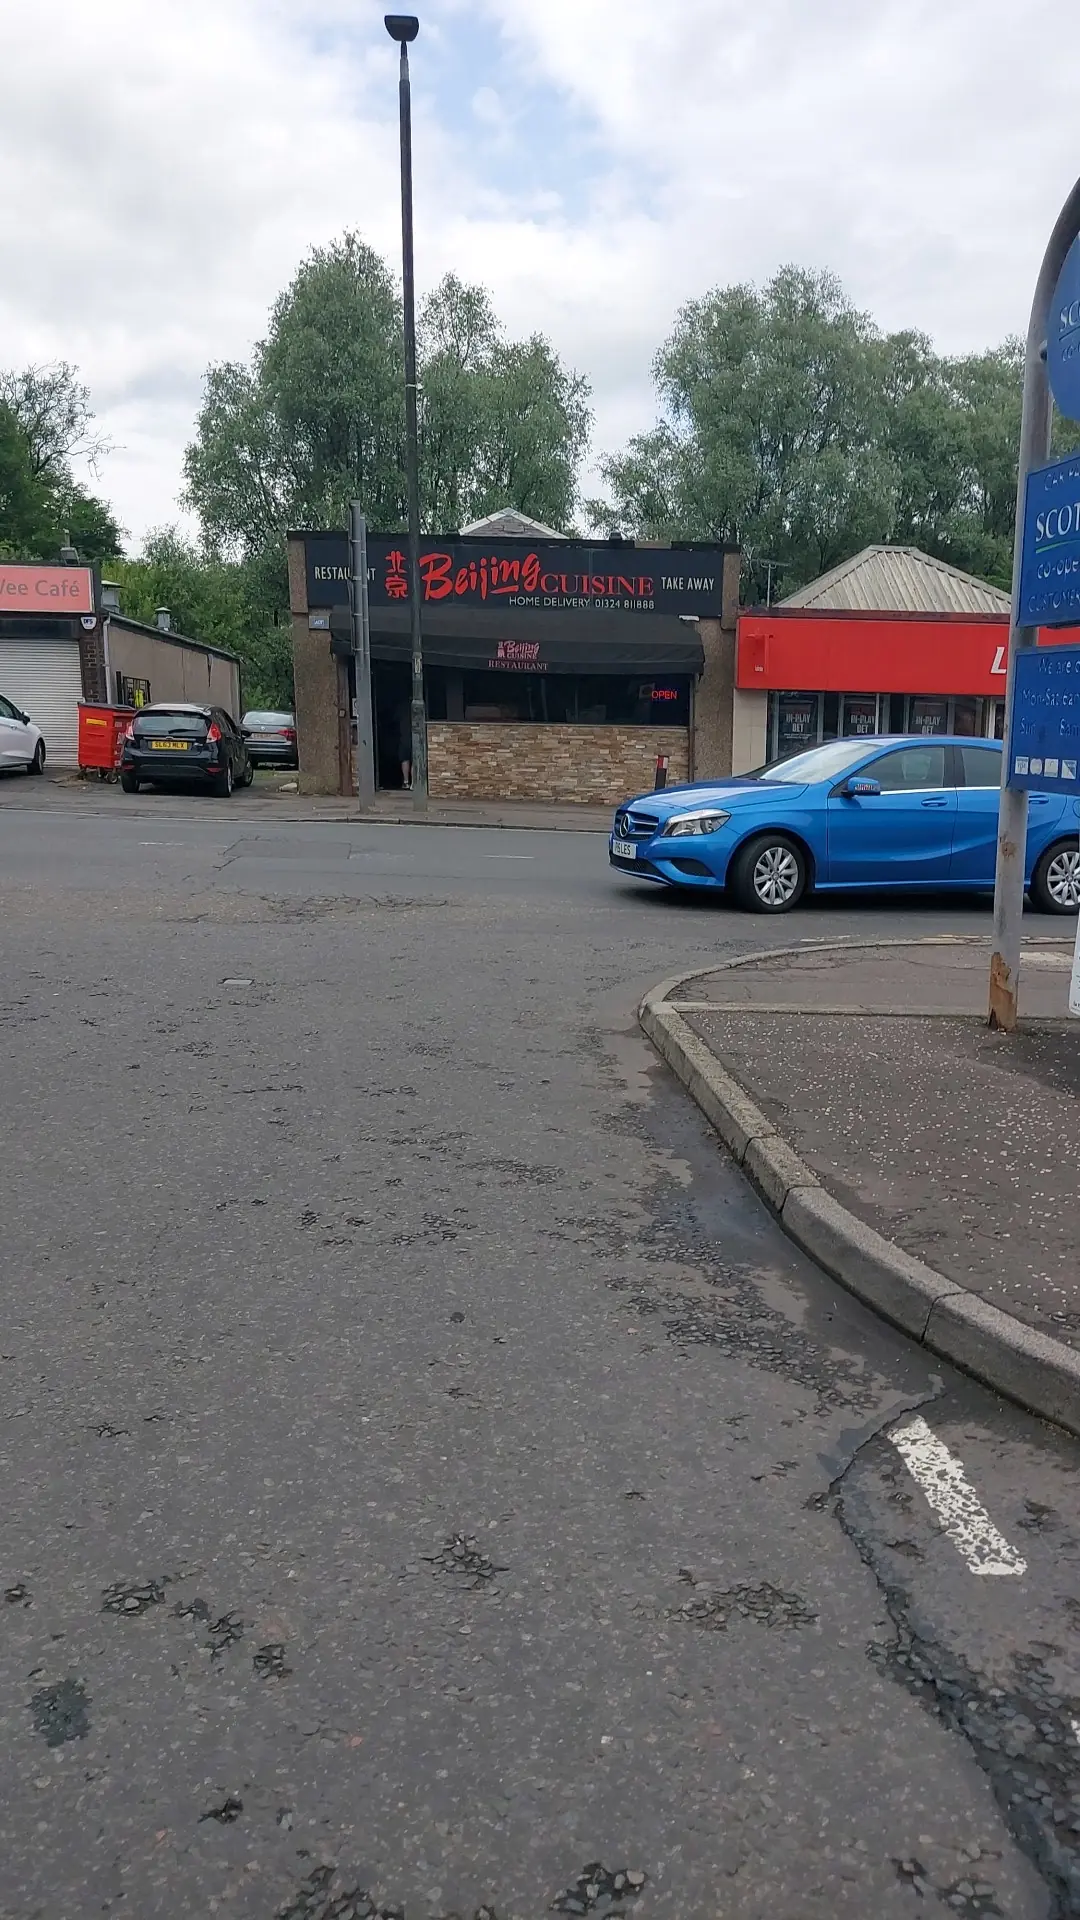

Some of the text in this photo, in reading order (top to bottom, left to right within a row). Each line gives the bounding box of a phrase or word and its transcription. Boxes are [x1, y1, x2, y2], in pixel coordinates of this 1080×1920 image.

[1060, 300, 1080, 332] SC
[385, 551, 408, 598] 北京
[419, 553, 654, 600] Beijing CUISINE
[0, 579, 80, 597] ee Café
[661, 576, 715, 591] TAKE AWAY
[509, 596, 540, 607] HOME
[543, 597, 590, 608] DELIVERY
[595, 599, 621, 609] 01324
[488, 660, 548, 670] RESTAURANT
[651, 690, 678, 700] OPEN
